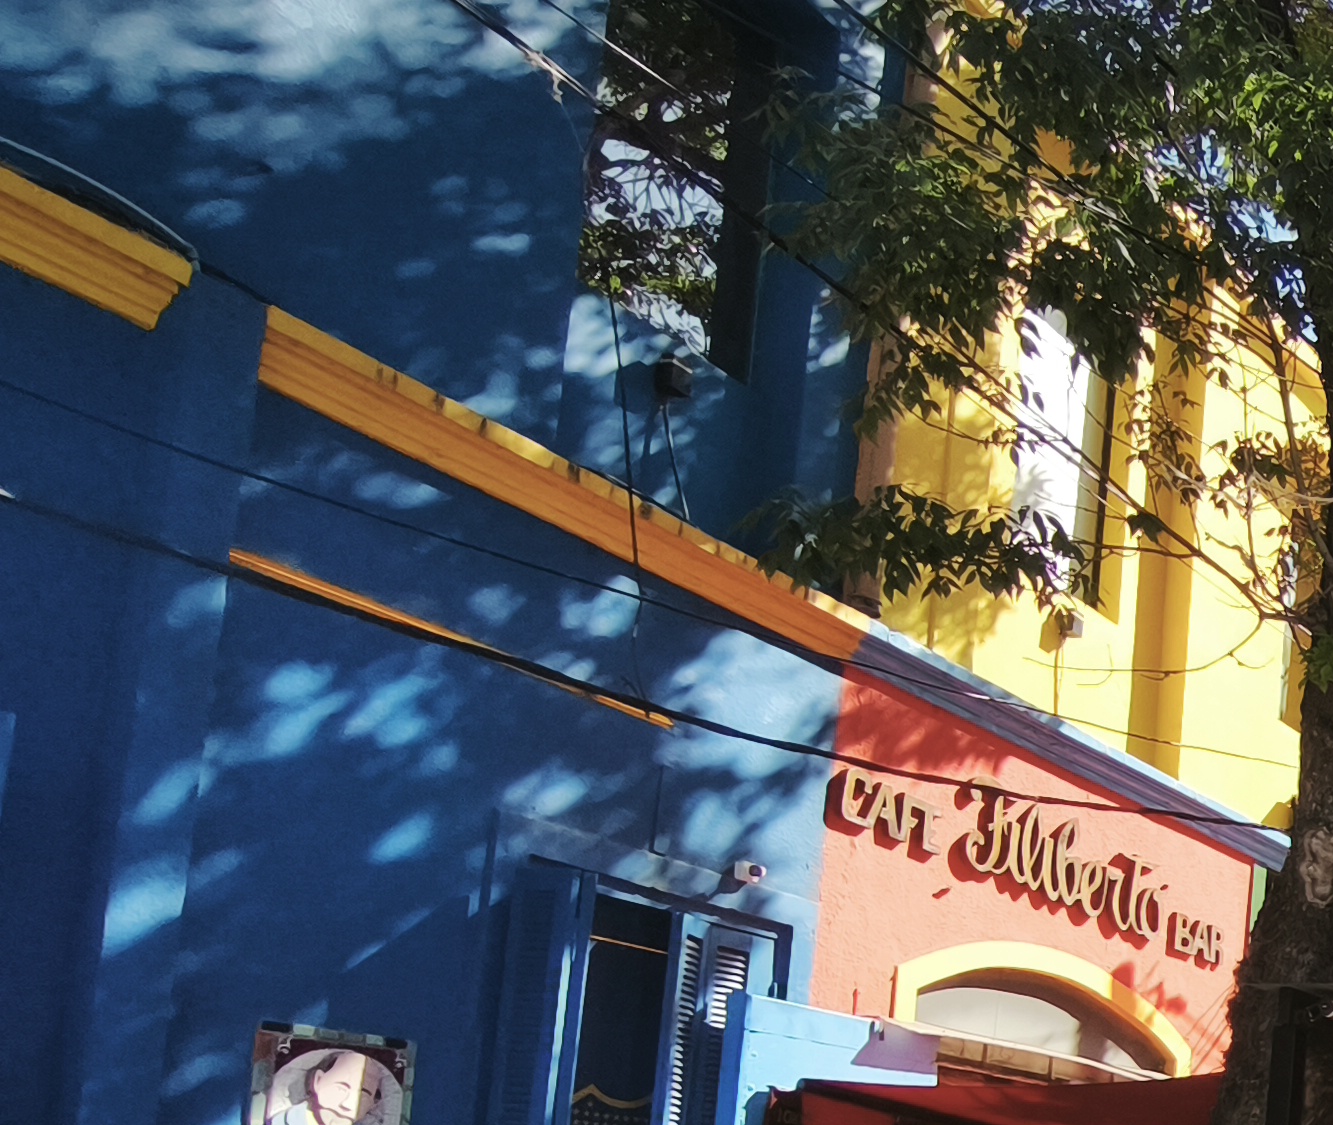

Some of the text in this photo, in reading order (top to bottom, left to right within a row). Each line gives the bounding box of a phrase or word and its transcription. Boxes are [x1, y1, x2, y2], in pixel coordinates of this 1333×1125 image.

[842, 771, 1225, 965] CAFE Filiberto BAR
